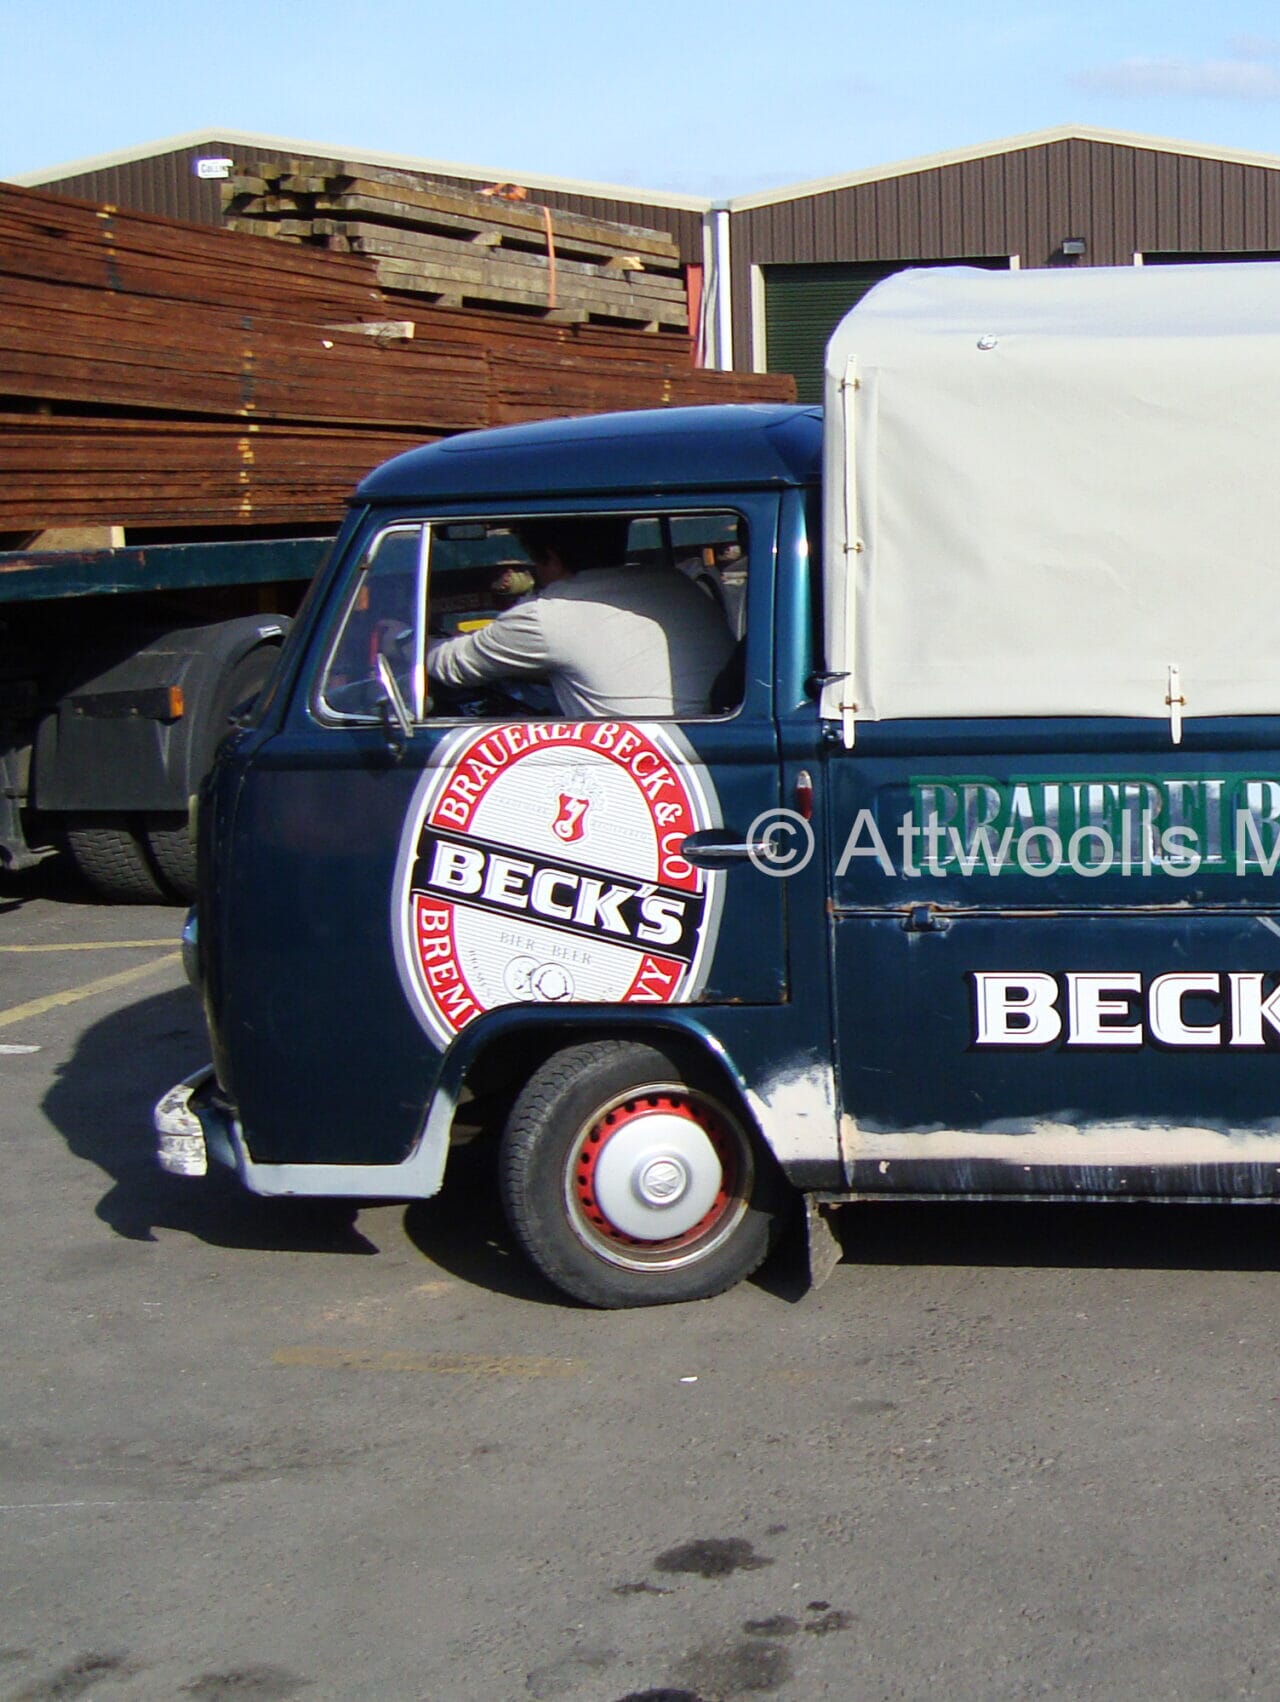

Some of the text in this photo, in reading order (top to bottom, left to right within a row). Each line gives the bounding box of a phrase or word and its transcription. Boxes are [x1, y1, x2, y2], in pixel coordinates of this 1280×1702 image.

[439, 723, 693, 879] BRAUEREI BECK & CO
[430, 841, 686, 946] BECK'S
